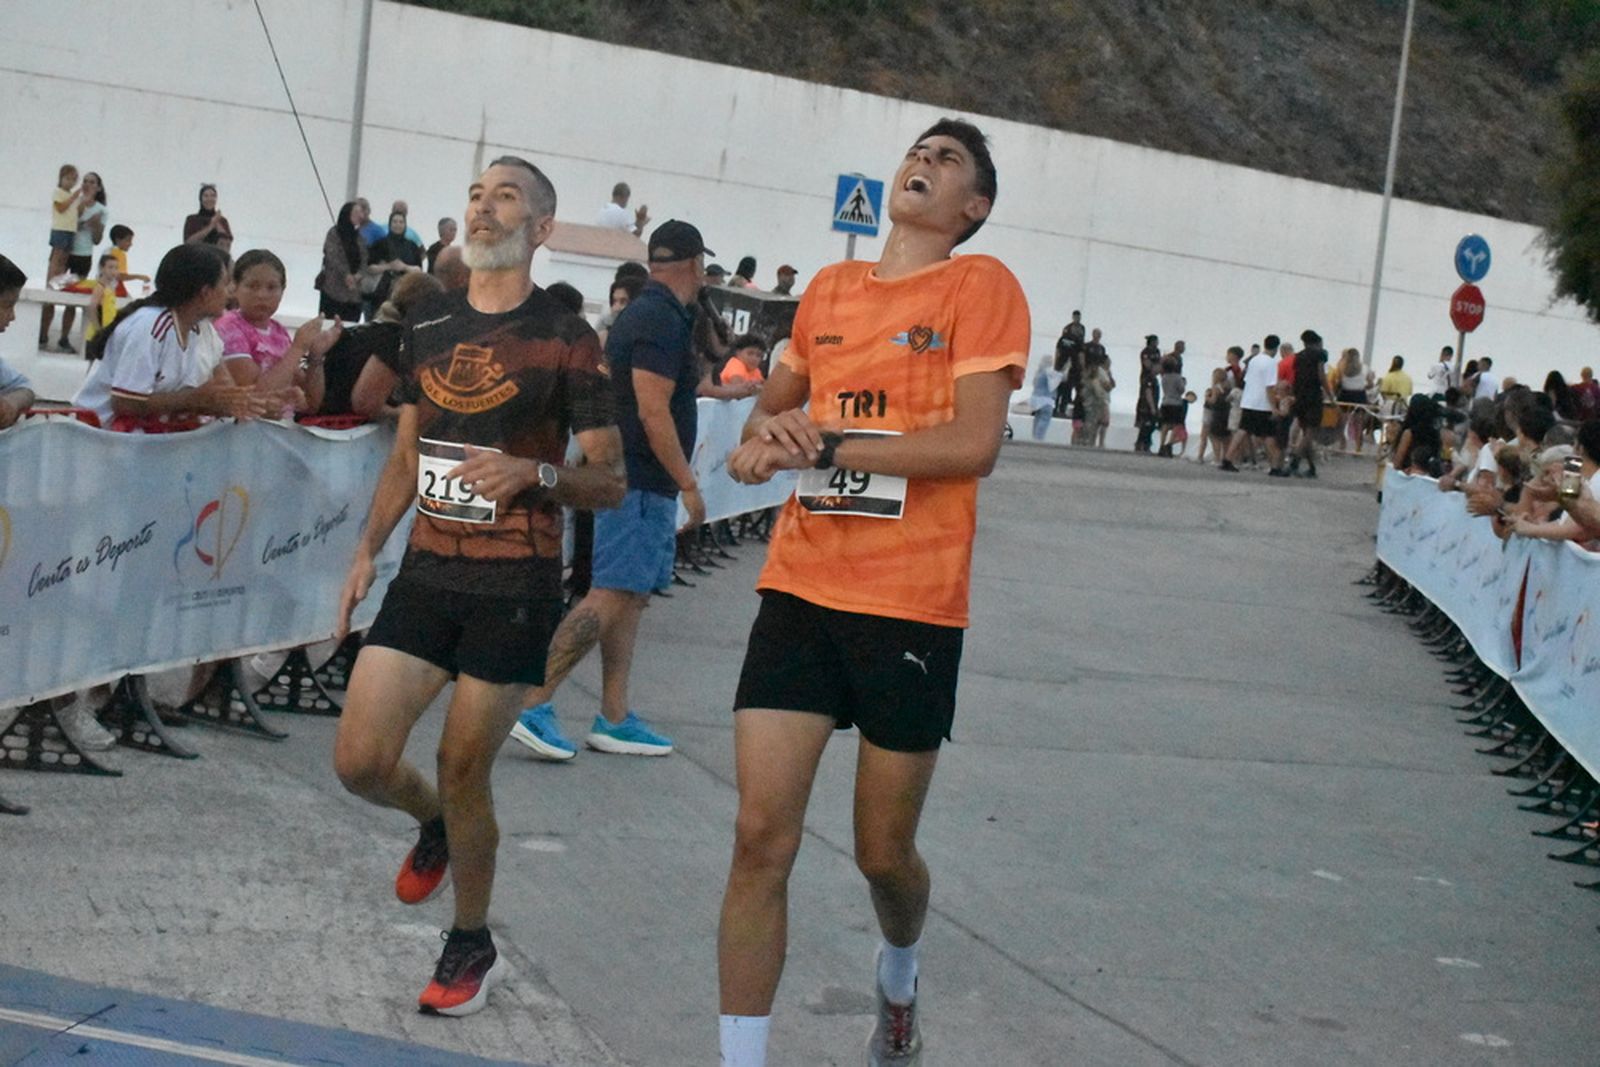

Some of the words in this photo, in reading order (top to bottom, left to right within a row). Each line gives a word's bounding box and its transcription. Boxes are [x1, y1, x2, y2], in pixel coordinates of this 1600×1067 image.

[1456, 301, 1483, 315] STOP
[837, 389, 887, 419] TRI
[424, 470, 476, 504] 219
[828, 469, 871, 495] 49
[96, 520, 156, 572] Deporte
